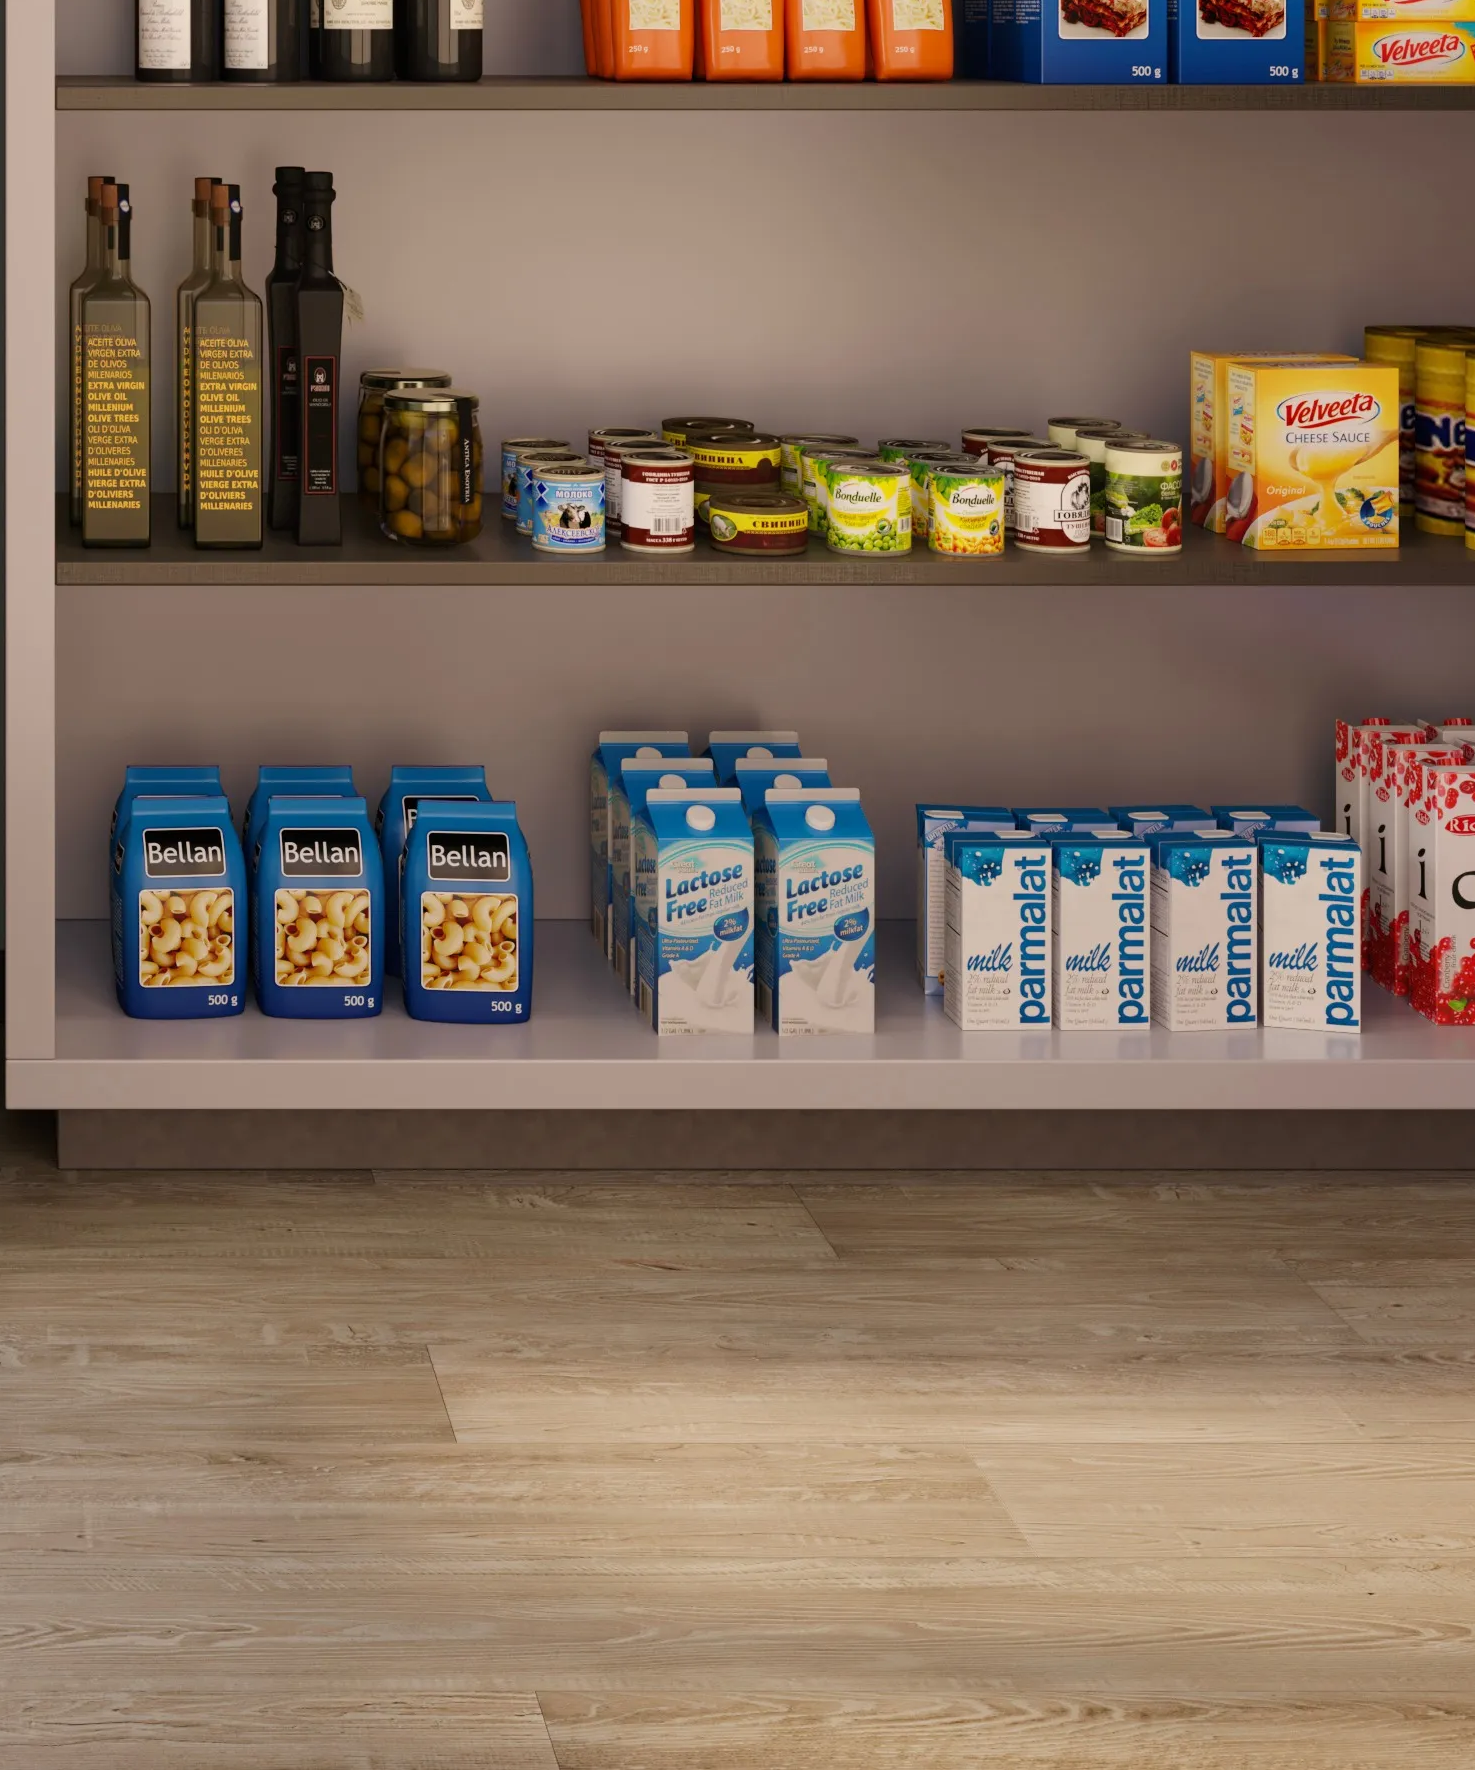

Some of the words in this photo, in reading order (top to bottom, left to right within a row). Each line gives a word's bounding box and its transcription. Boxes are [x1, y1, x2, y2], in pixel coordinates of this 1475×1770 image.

[804, 45, 817, 53] 250
[1132, 66, 1151, 77] 500
[1154, 68, 1161, 79] g
[88, 360, 98, 368] DE
[100, 360, 127, 368] OLIVOS
[88, 371, 132, 379] MILENARIOS
[117, 382, 145, 390] VIRGIN
[1283, 393, 1374, 427] Velveeta
[88, 436, 112, 444] VERGE
[114, 436, 138, 444] EXTRA
[1286, 431, 1328, 444] CHEESE
[1332, 430, 1370, 443] SAUCE
[88, 447, 131, 455] D'OLIVERES
[88, 458, 135, 466] MILLENARIES
[88, 469, 112, 477] HUILE
[88, 480, 117, 488] VIERGE
[88, 490, 133, 498] D'OLIVIERS
[556, 490, 592, 499] МОЛОКО
[1267, 485, 1306, 497] Original
[834, 489, 882, 504] Bonduelle
[88, 501, 140, 509] MILLENARIES
[752, 518, 805, 528] СВИНИНА
[431, 845, 506, 868] Bellan
[666, 864, 742, 899] Lactose
[710, 879, 748, 898] Reduced
[710, 899, 722, 909] Fat
[724, 891, 743, 904] Milk
[667, 898, 707, 922] Free
[724, 919, 736, 928] 2%
[720, 925, 742, 936] milkfat
[1013, 855, 1050, 1024] parmalat
[1318, 857, 1359, 1027] parmalat
[968, 942, 1013, 972] milk
